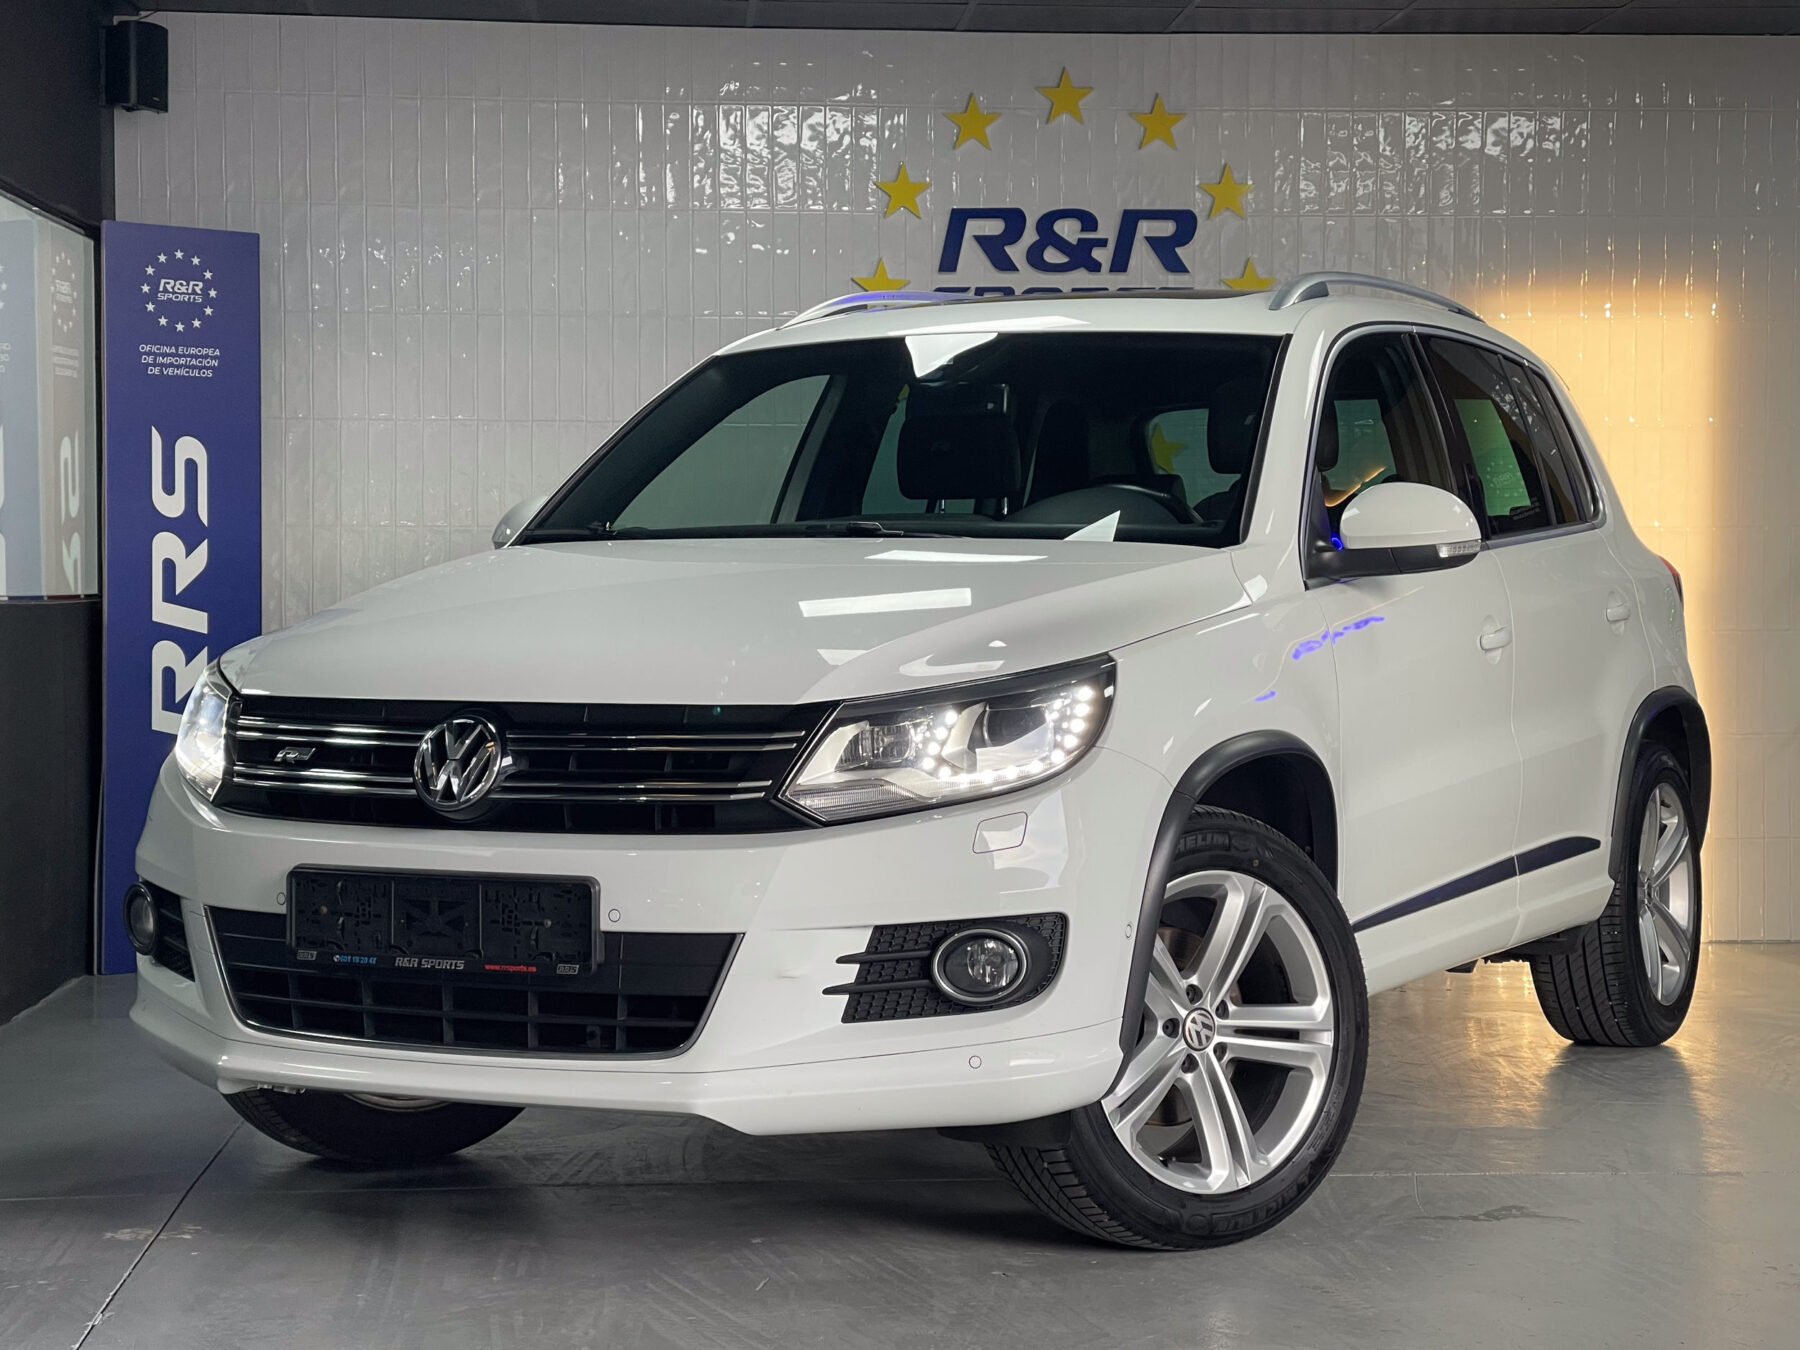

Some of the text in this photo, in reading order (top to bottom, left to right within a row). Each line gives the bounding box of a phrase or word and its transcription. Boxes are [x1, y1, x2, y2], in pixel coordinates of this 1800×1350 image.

[938, 207, 1198, 273] R&R
[159, 279, 203, 294] R&R
[157, 292, 203, 303] SPORTS
[139, 344, 220, 356] OFICINA EUROPEA
[141, 355, 218, 367] DE IMPORTACIÓN
[147, 366, 213, 378] DE VEHÍCULOS
[151, 425, 209, 736] RRS
[395, 957, 465, 970] R&R SPORTS
